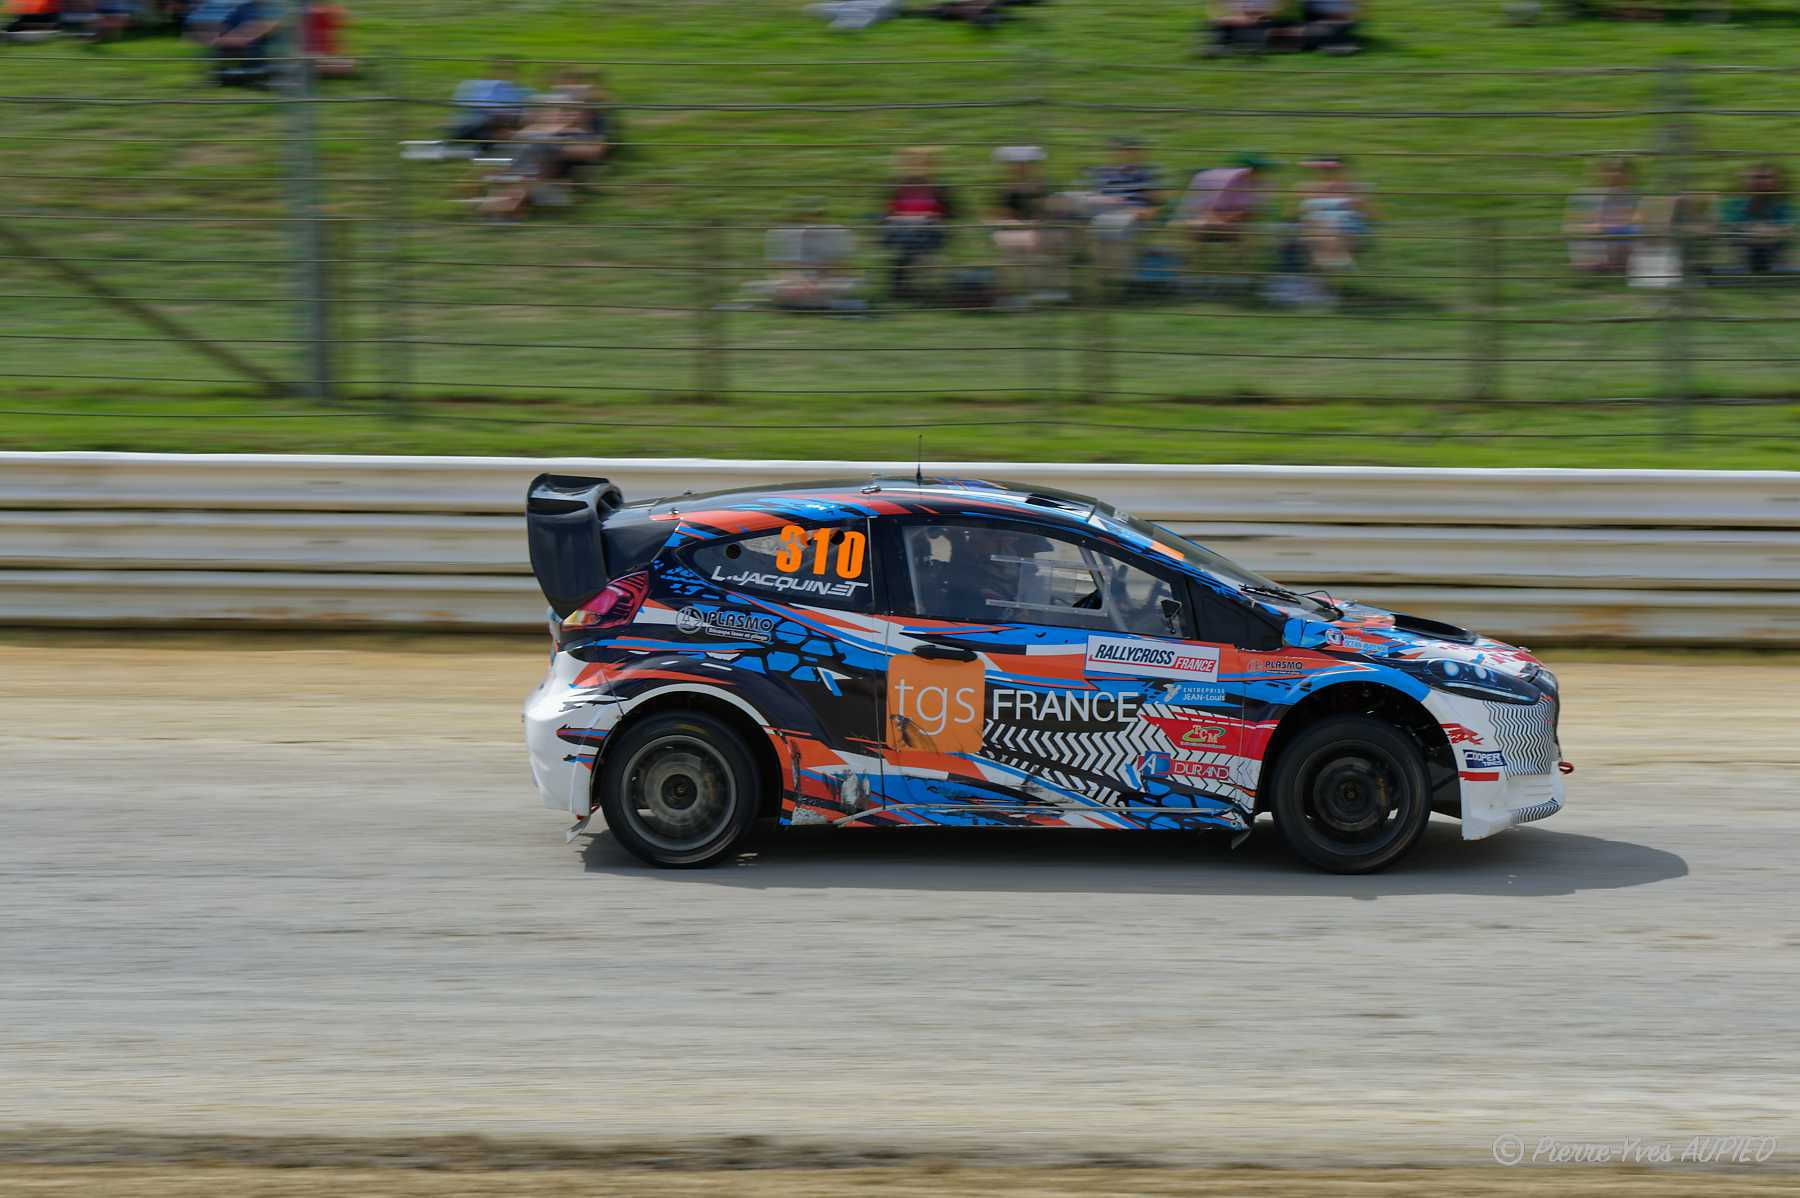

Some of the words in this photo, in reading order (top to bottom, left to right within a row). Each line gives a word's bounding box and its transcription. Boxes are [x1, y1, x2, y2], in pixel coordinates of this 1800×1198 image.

[776, 524, 866, 579] 310
[711, 565, 869, 597] L.JACQUINET
[706, 611, 775, 633] PLASMO
[1095, 643, 1175, 665] RALLYCROSS
[1174, 657, 1216, 673] FRANCE
[1265, 660, 1303, 670] PLASMO
[895, 678, 976, 736] tgs
[992, 688, 1139, 723] FRANCE
[1174, 761, 1230, 779] DURAND
[1465, 752, 1501, 761] COOPER
